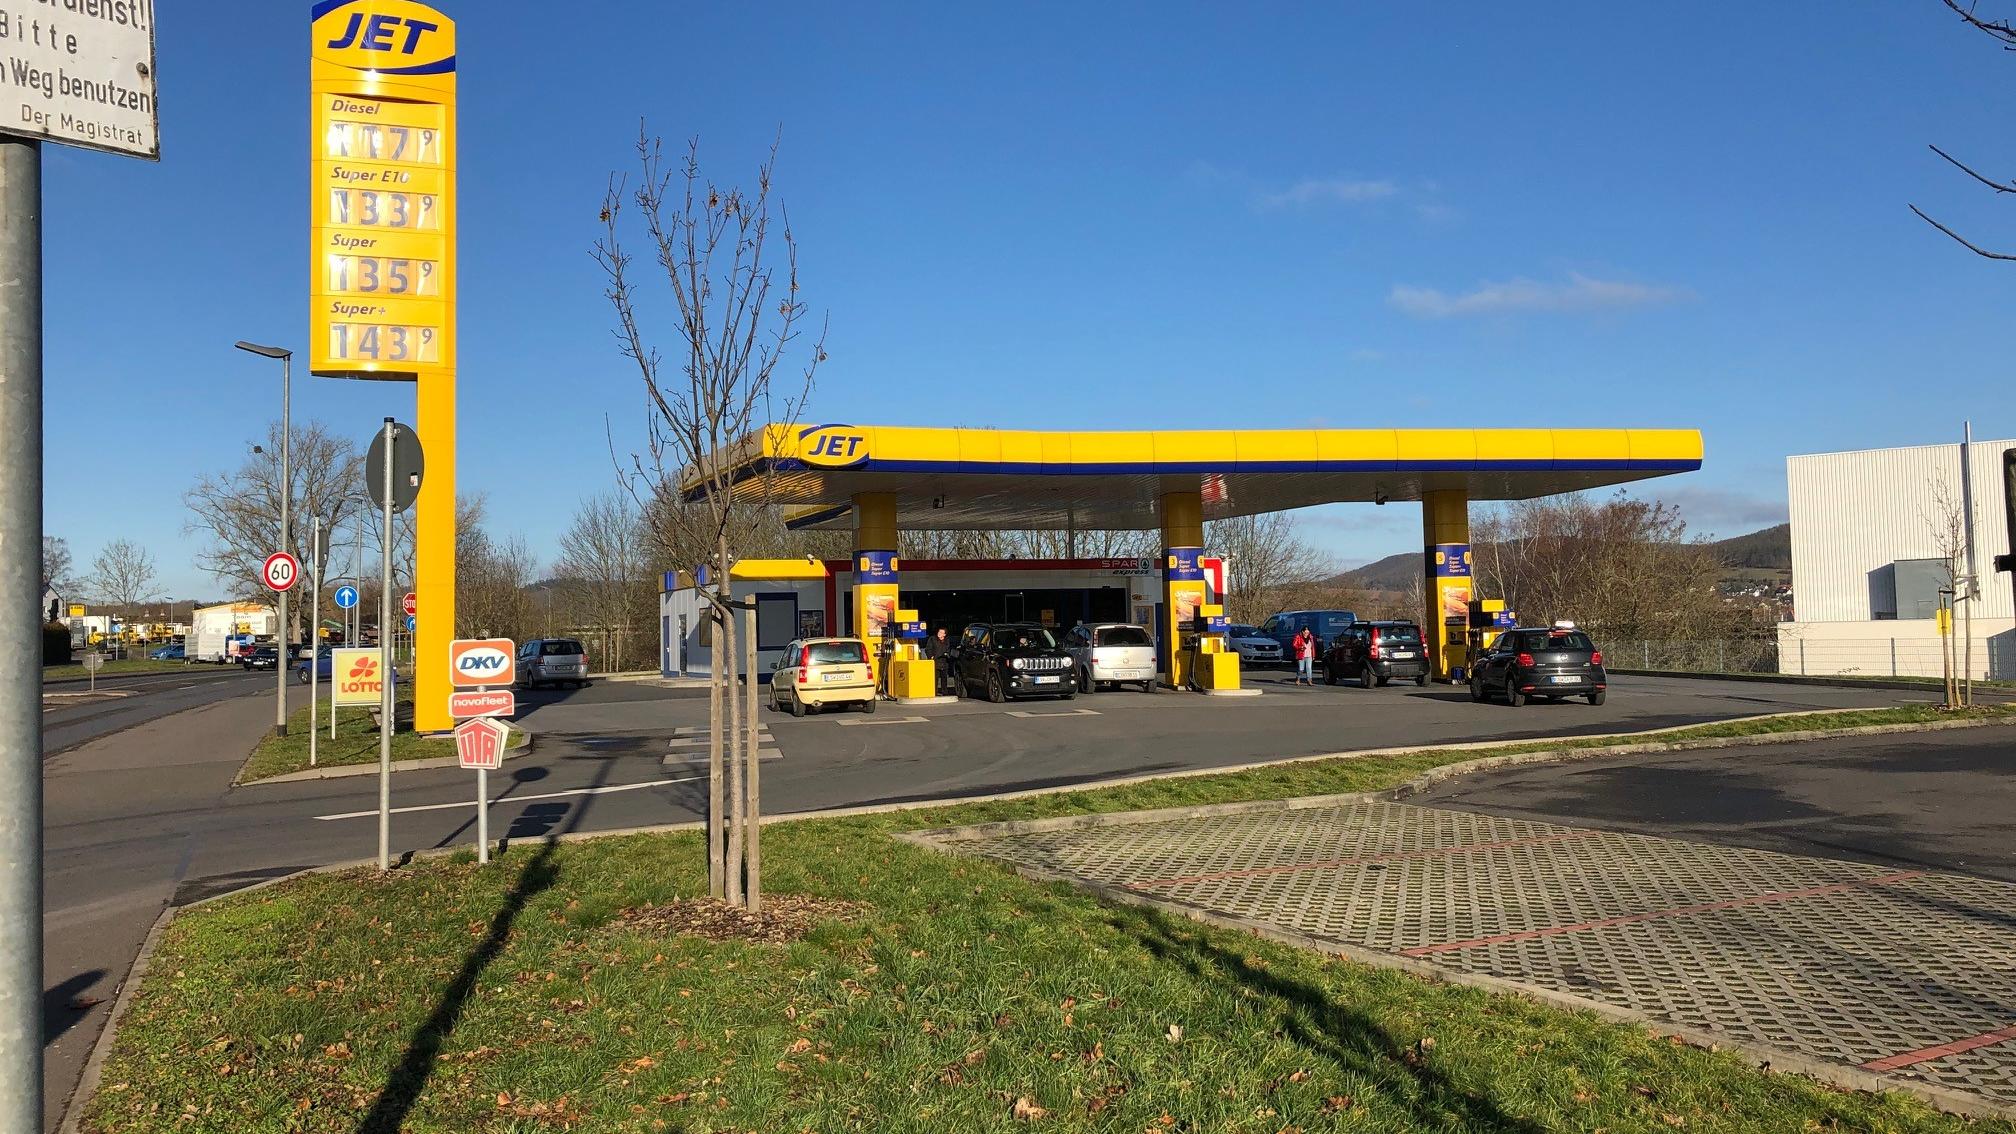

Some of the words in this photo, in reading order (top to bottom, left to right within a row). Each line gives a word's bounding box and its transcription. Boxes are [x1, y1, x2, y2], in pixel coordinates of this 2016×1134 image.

[0, 9, 78, 55] Bitte
[327, 12, 438, 55] JET
[10, 56, 54, 99] Weg
[59, 67, 151, 113] benutzen
[331, 99, 380, 115] Diesel
[21, 103, 52, 126] Der
[60, 112, 143, 146] Magistrat
[331, 166, 377, 183] Super
[381, 170, 409, 184] E10
[331, 234, 377, 250] Super
[808, 435, 864, 457] JET
[271, 563, 290, 580] 60
[1101, 560, 1138, 568] SPAR
[404, 599, 416, 609] STO
[460, 656, 505, 670] DKV
[454, 696, 509, 707] novofleet
[460, 721, 499, 765] UTA
